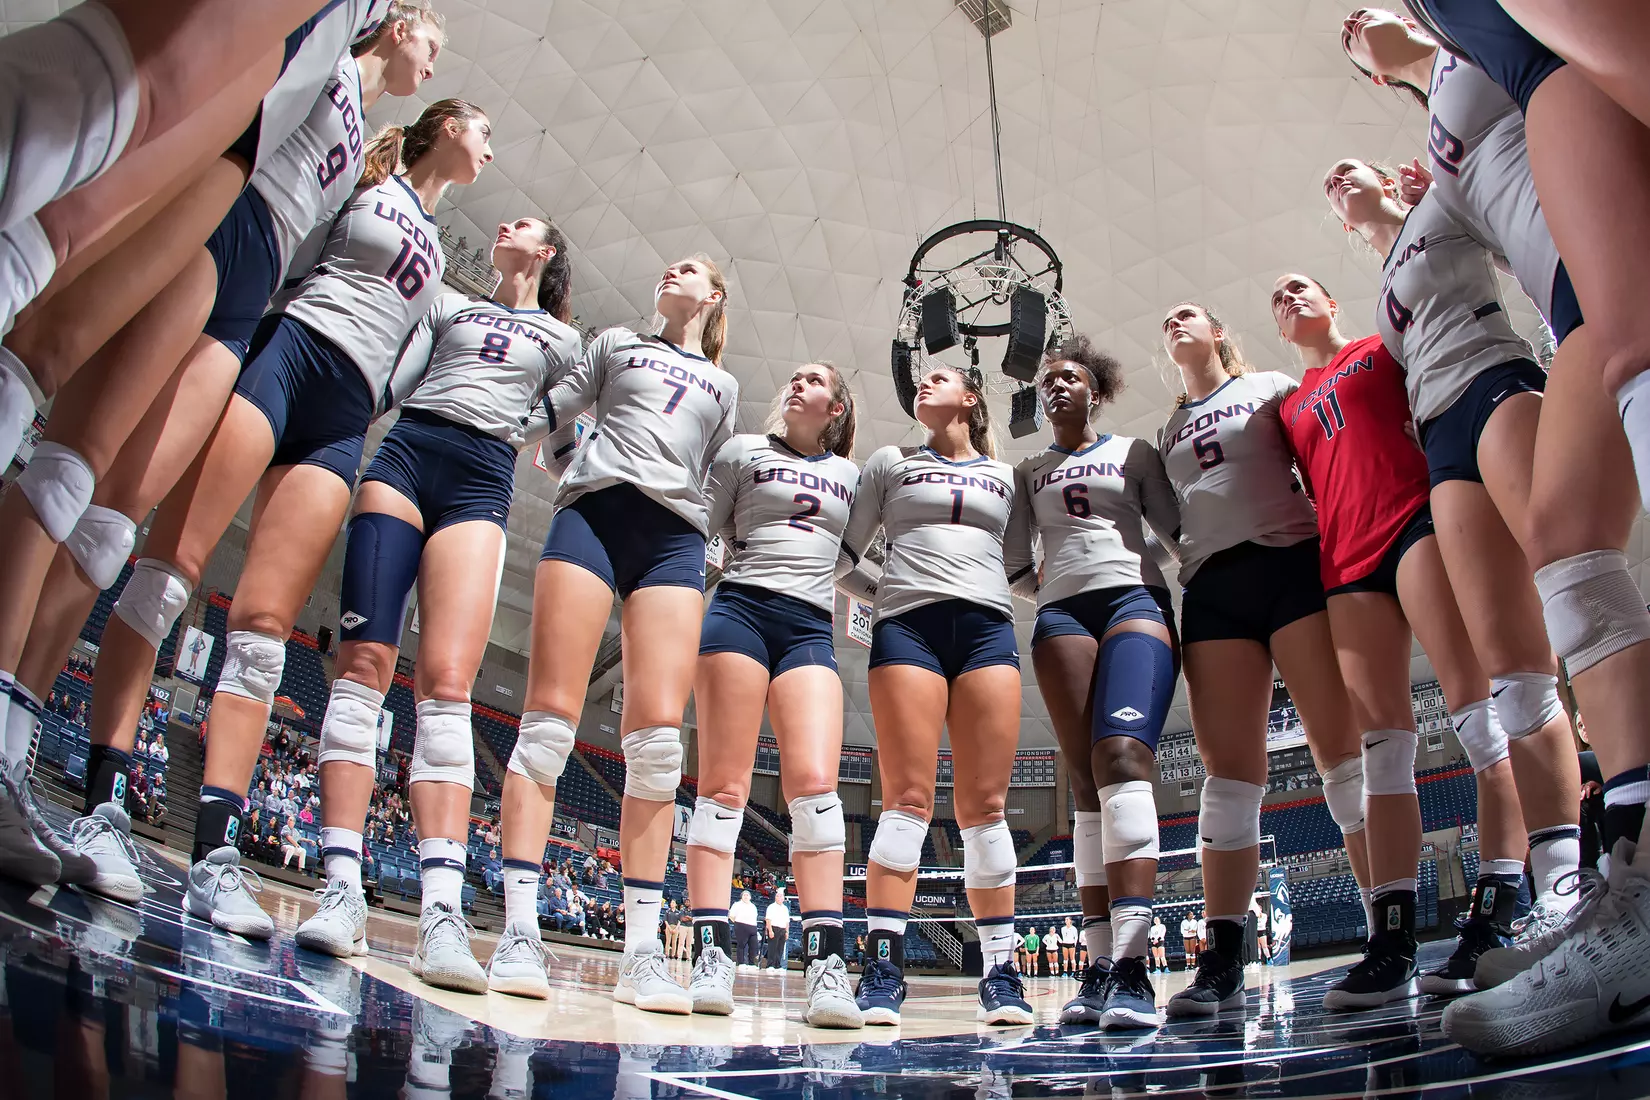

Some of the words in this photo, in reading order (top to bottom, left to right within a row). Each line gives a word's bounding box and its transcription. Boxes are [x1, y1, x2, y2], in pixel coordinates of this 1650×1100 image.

[1428, 113, 1465, 178] 19
[316, 141, 348, 191] 9
[384, 236, 431, 301] 16
[1386, 286, 1415, 335] 4
[453, 312, 551, 351] UCONN
[477, 331, 512, 365] 8
[627, 355, 722, 403] UCONN
[661, 376, 688, 416] 7
[1291, 355, 1374, 427] UCONN
[1166, 401, 1256, 456] UCONN
[1311, 389, 1347, 441] 11
[1191, 428, 1226, 471] 5
[753, 467, 853, 506] UCONN
[902, 472, 1006, 500] UCONN
[1033, 462, 1126, 494] UCONN
[788, 492, 822, 533] 2
[948, 488, 966, 525] 1
[1061, 482, 1093, 520] 6
[343, 616, 359, 624] PRO
[154, 688, 170, 701] 107
[1423, 698, 1436, 709] 00
[1161, 749, 1174, 759] 42
[1177, 747, 1190, 756] 44
[1162, 771, 1175, 780] 24
[1179, 768, 1190, 777] 13
[563, 824, 577, 834] 109
[608, 839, 620, 848] 110
[1298, 865, 1309, 873] 116
[915, 895, 946, 904] UCONN
